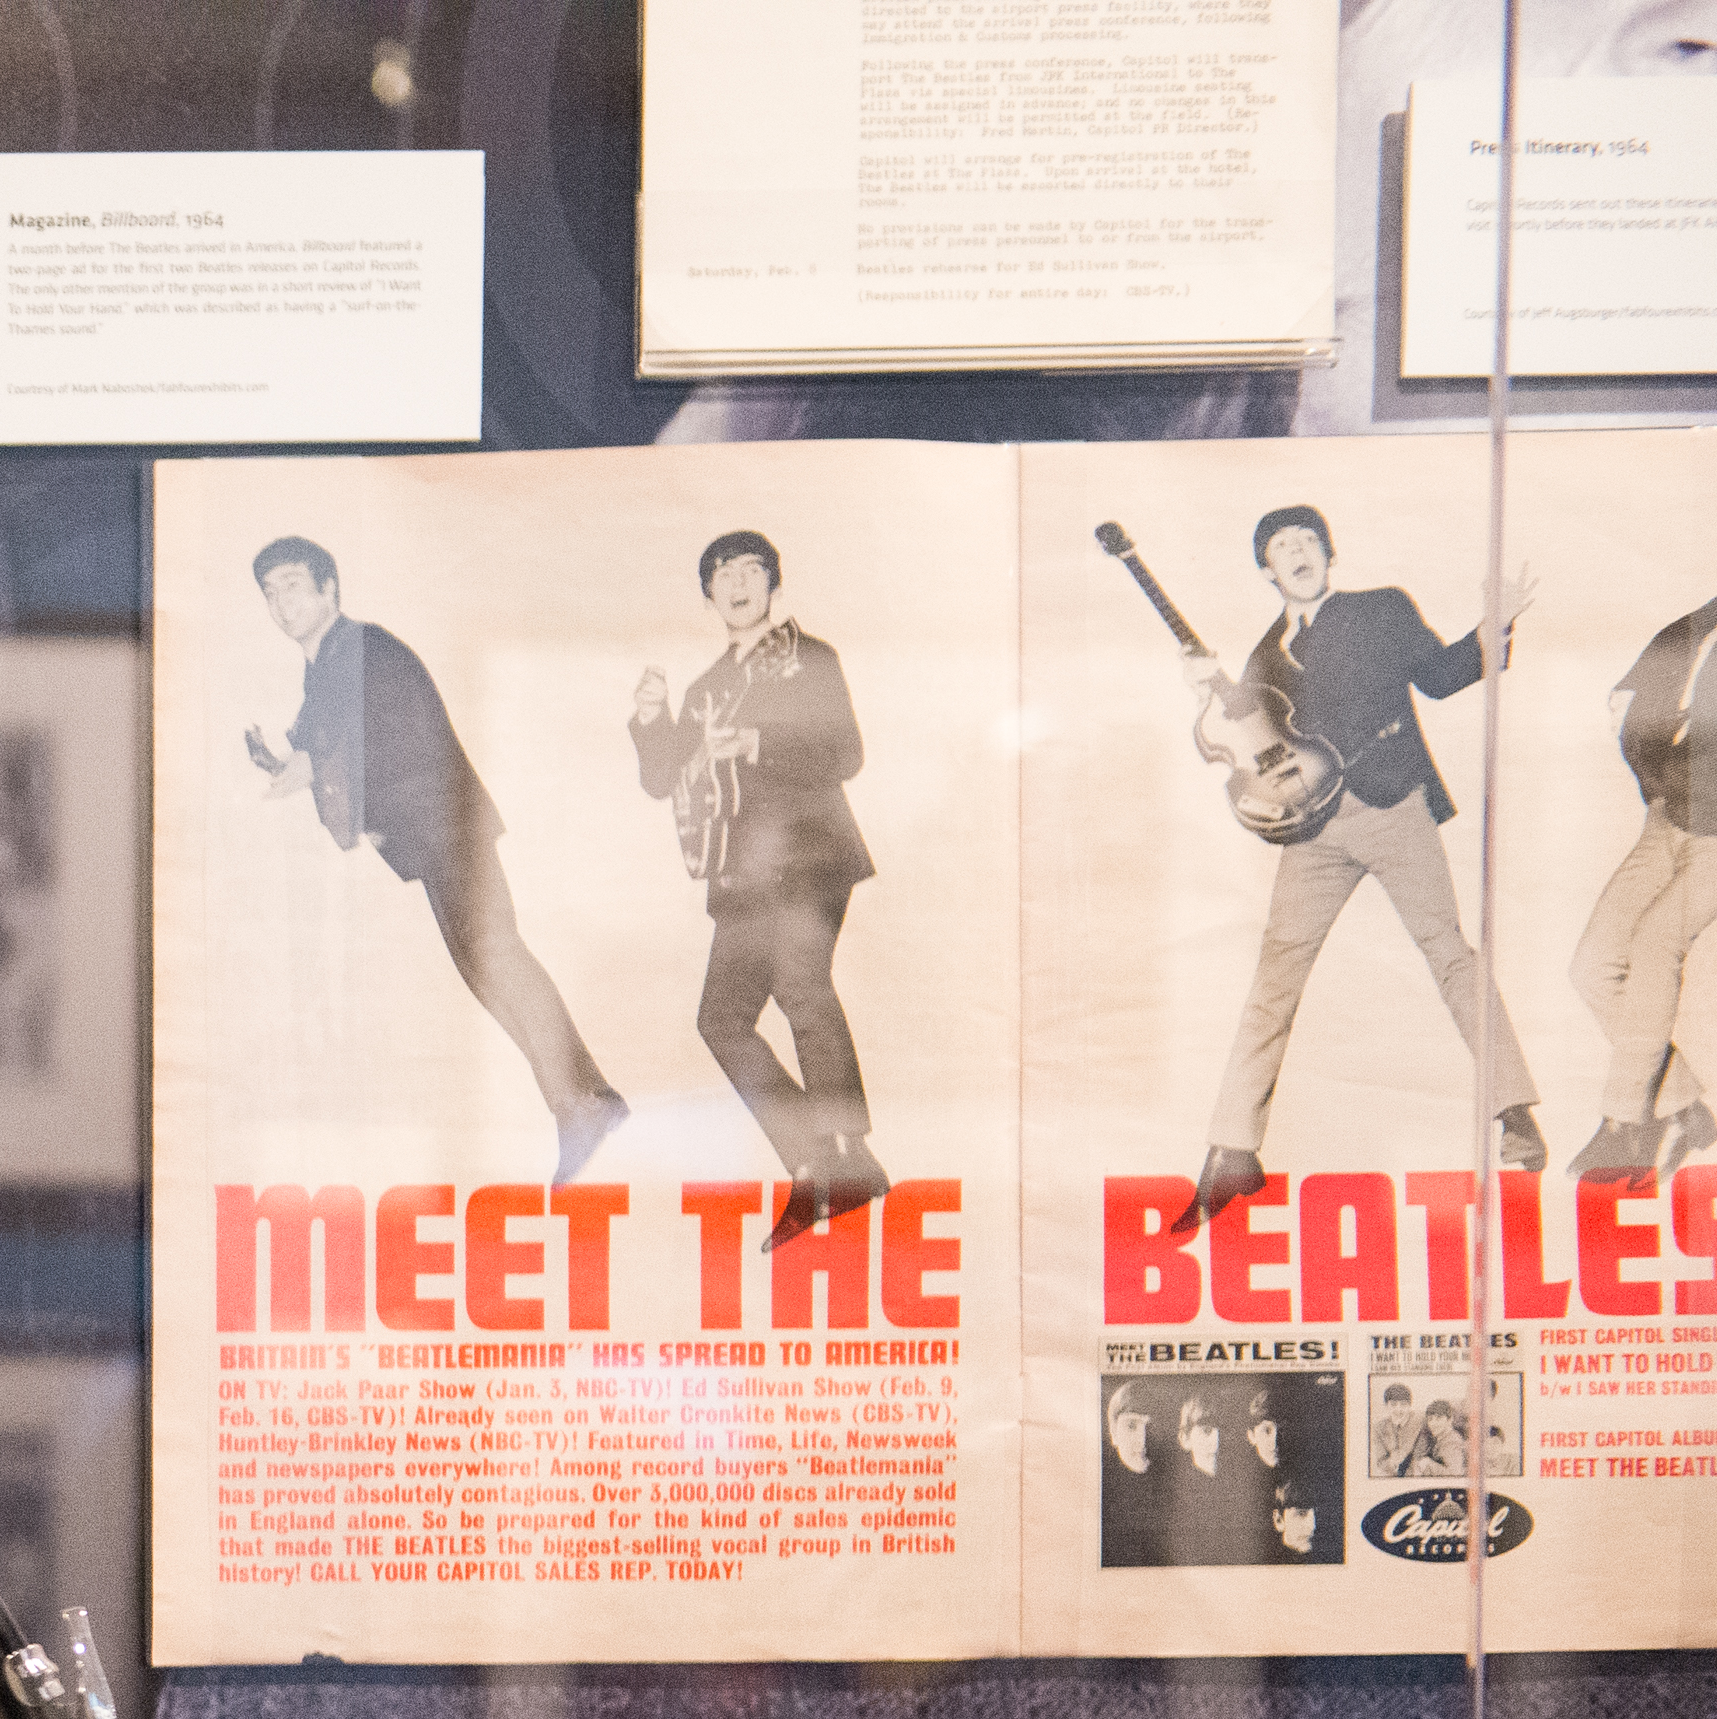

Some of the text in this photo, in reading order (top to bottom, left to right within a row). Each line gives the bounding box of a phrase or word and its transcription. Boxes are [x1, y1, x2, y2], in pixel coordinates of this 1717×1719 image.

[1525, 139, 1604, 157] Itinerary,
[1609, 137, 1651, 157] 1964
[7, 211, 225, 233] Magazine, Billboard, 1964
[215, 1178, 962, 1332] MEET THE
[1371, 1333, 1518, 1350] THE BEATES
[1539, 1328, 1587, 1346] FIRST
[1594, 1327, 1665, 1346] CAPITOL
[219, 1339, 960, 1370] BRITAIN'S "BEATLEMANIA" HAS SPREAD TO AMERICA!
[1106, 1342, 1144, 1352] MEET
[1149, 1340, 1340, 1363] BEATLES!
[1107, 1352, 1146, 1363] THE
[1539, 1351, 1715, 1375] I WANT TO HOLD
[1540, 1381, 1571, 1398] b/w
[1576, 1381, 1582, 1396] I
[1588, 1381, 1620, 1396] SAW
[1625, 1380, 1656, 1396] HER
[1540, 1429, 1717, 1449] FIRST CAPITOL ALBU
[1540, 1457, 1598, 1478] MEET
[1606, 1457, 1648, 1478] THE
[218, 1558, 744, 1586] history! CALL YOUR CAPITOL SALES REP. TODAY!
